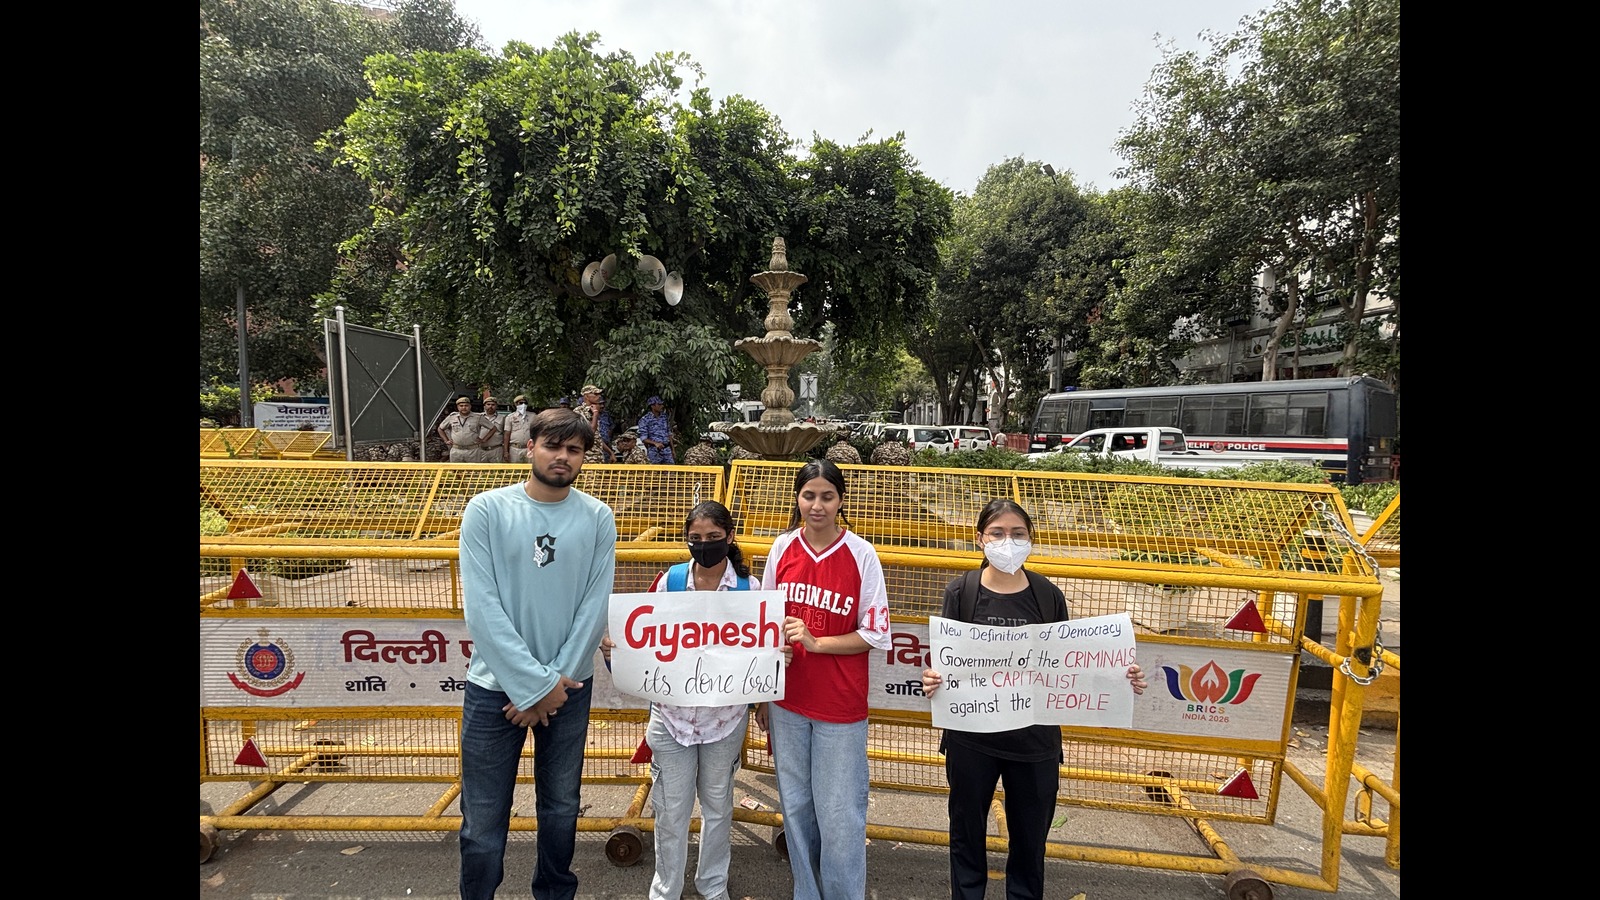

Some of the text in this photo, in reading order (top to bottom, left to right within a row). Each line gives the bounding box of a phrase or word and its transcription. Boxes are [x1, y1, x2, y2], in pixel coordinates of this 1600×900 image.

[277, 405, 328, 415] चेतावनी
[866, 605, 889, 634] 13
[624, 600, 780, 662] Gyanesh
[940, 621, 1121, 642] New Definition of Democracy
[340, 629, 450, 665] दिल्ली
[940, 646, 1136, 669] Government of the CRIMINALS
[345, 675, 387, 692] शांति
[637, 657, 780, 697] its done bro!
[946, 670, 1080, 691] for the CAPITALIST
[949, 692, 1111, 717] against the PEOPLE
[1186, 704, 1226, 714] BRICS
[1182, 713, 1230, 723] INDIA 2026
